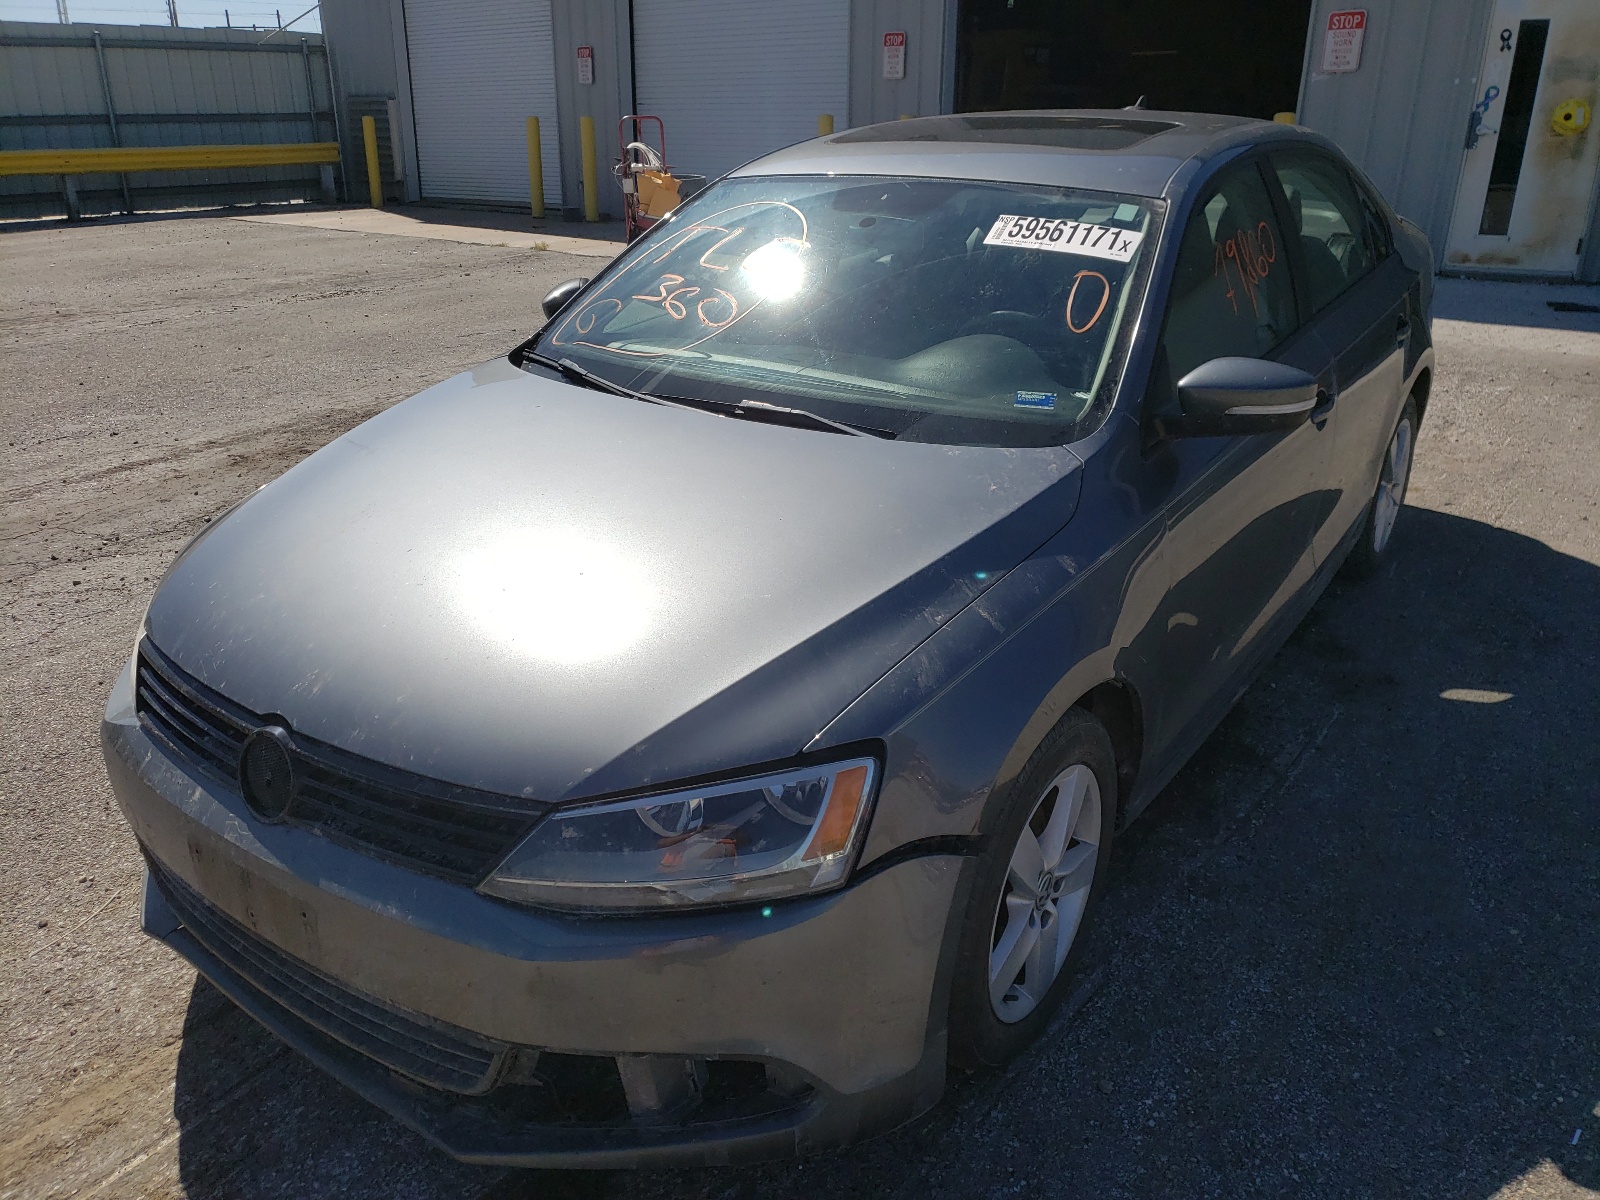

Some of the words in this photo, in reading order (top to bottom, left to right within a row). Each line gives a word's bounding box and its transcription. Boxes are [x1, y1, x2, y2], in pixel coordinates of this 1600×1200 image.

[1331, 14, 1362, 29] STOP
[885, 35, 903, 46] STOP
[998, 216, 1016, 224] NSP
[1007, 216, 1123, 250] 59561171
[632, 273, 738, 328] 360
